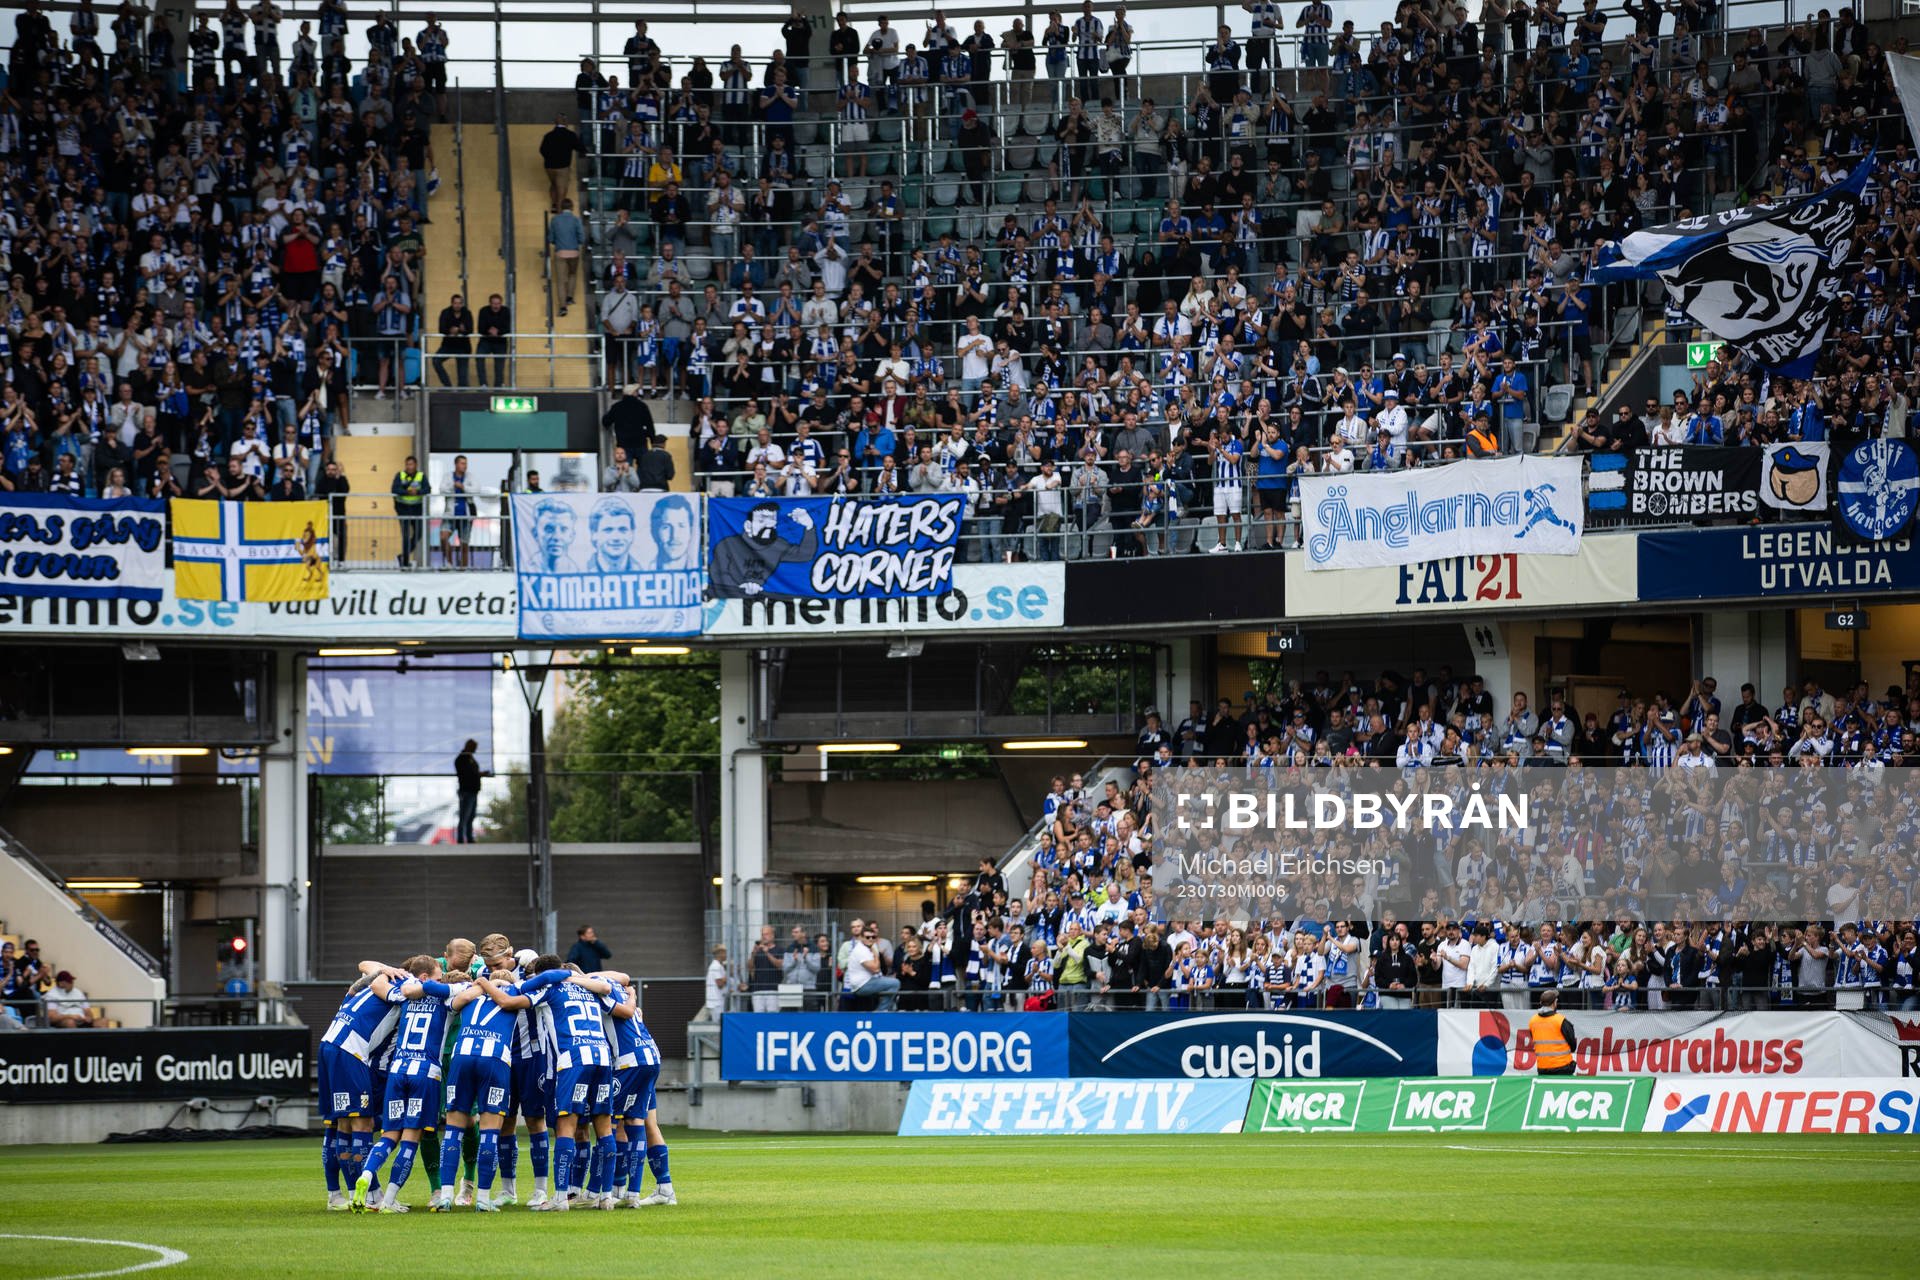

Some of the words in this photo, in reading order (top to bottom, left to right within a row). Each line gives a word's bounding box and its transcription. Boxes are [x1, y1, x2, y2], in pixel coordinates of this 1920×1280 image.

[1635, 449, 1684, 469] THE
[1633, 470, 1724, 492] BROWN
[824, 500, 961, 549] HATERS
[1309, 485, 1520, 564] Änglarna
[811, 547, 956, 593] CORNER
[1395, 553, 1523, 605] FAT21
[1761, 559, 1892, 589] UTVALDA
[331, 589, 378, 615] vill
[388, 589, 426, 615] du
[520, 572, 701, 610] KAMRATERNA
[1837, 614, 1854, 626] G2
[1279, 637, 1293, 649] G1
[471, 995, 502, 1027] 17
[563, 1000, 606, 1039] 29
[400, 1012, 433, 1051] 19
[756, 1031, 816, 1071] IFK
[824, 1020, 1032, 1072] GÖTEBORG
[74, 1055, 143, 1083] Ullevi
[155, 1054, 233, 1082] Gamla
[238, 1052, 303, 1080] Ullevi
[1181, 1030, 1321, 1078] cuebid
[1513, 1027, 1804, 1077] Bgkvarabuss
[921, 1081, 1196, 1131] EFFEKTIV
[1277, 1091, 1345, 1121] MCR
[1405, 1091, 1476, 1120] MCR
[1539, 1091, 1612, 1120] MCR
[1711, 1090, 1920, 1134] INTERS
